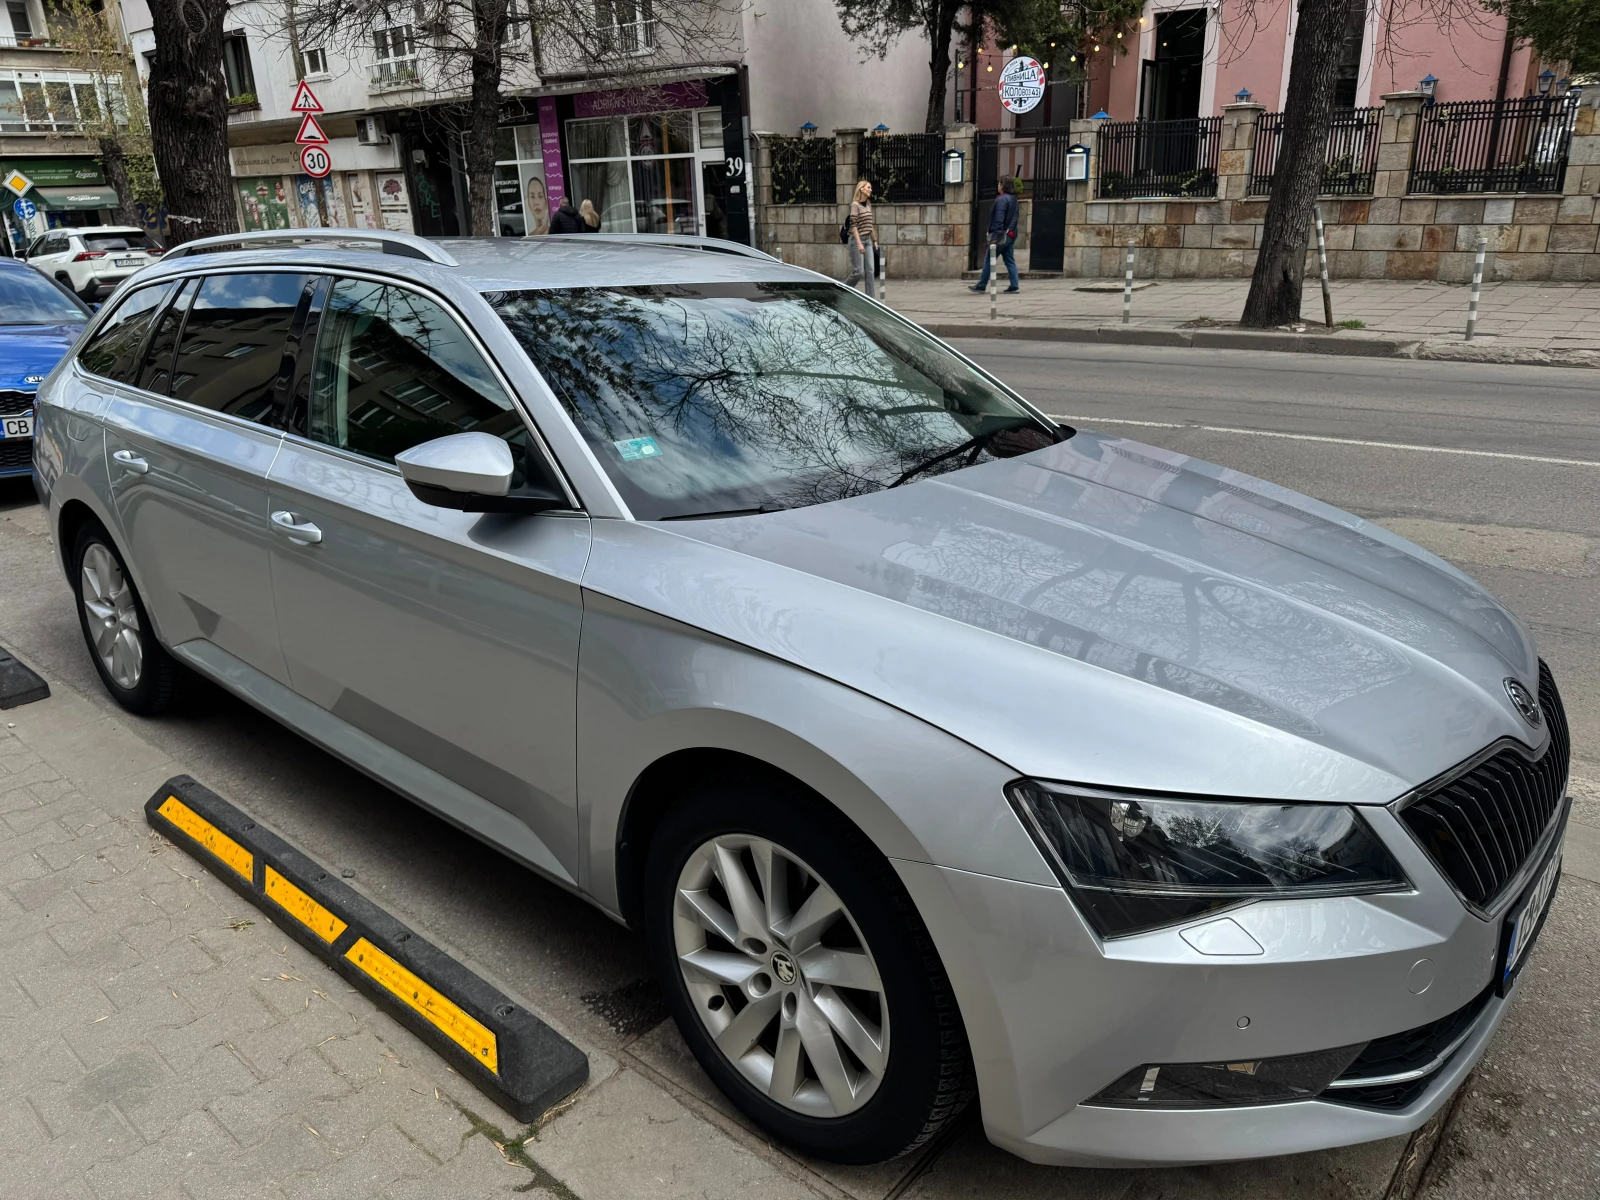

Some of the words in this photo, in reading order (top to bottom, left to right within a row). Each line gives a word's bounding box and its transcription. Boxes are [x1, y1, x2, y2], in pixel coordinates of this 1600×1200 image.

[1007, 69, 1037, 82] ПИВНИЦА
[307, 153, 326, 169] 30
[726, 157, 743, 177] 39
[6, 420, 29, 435] CB
